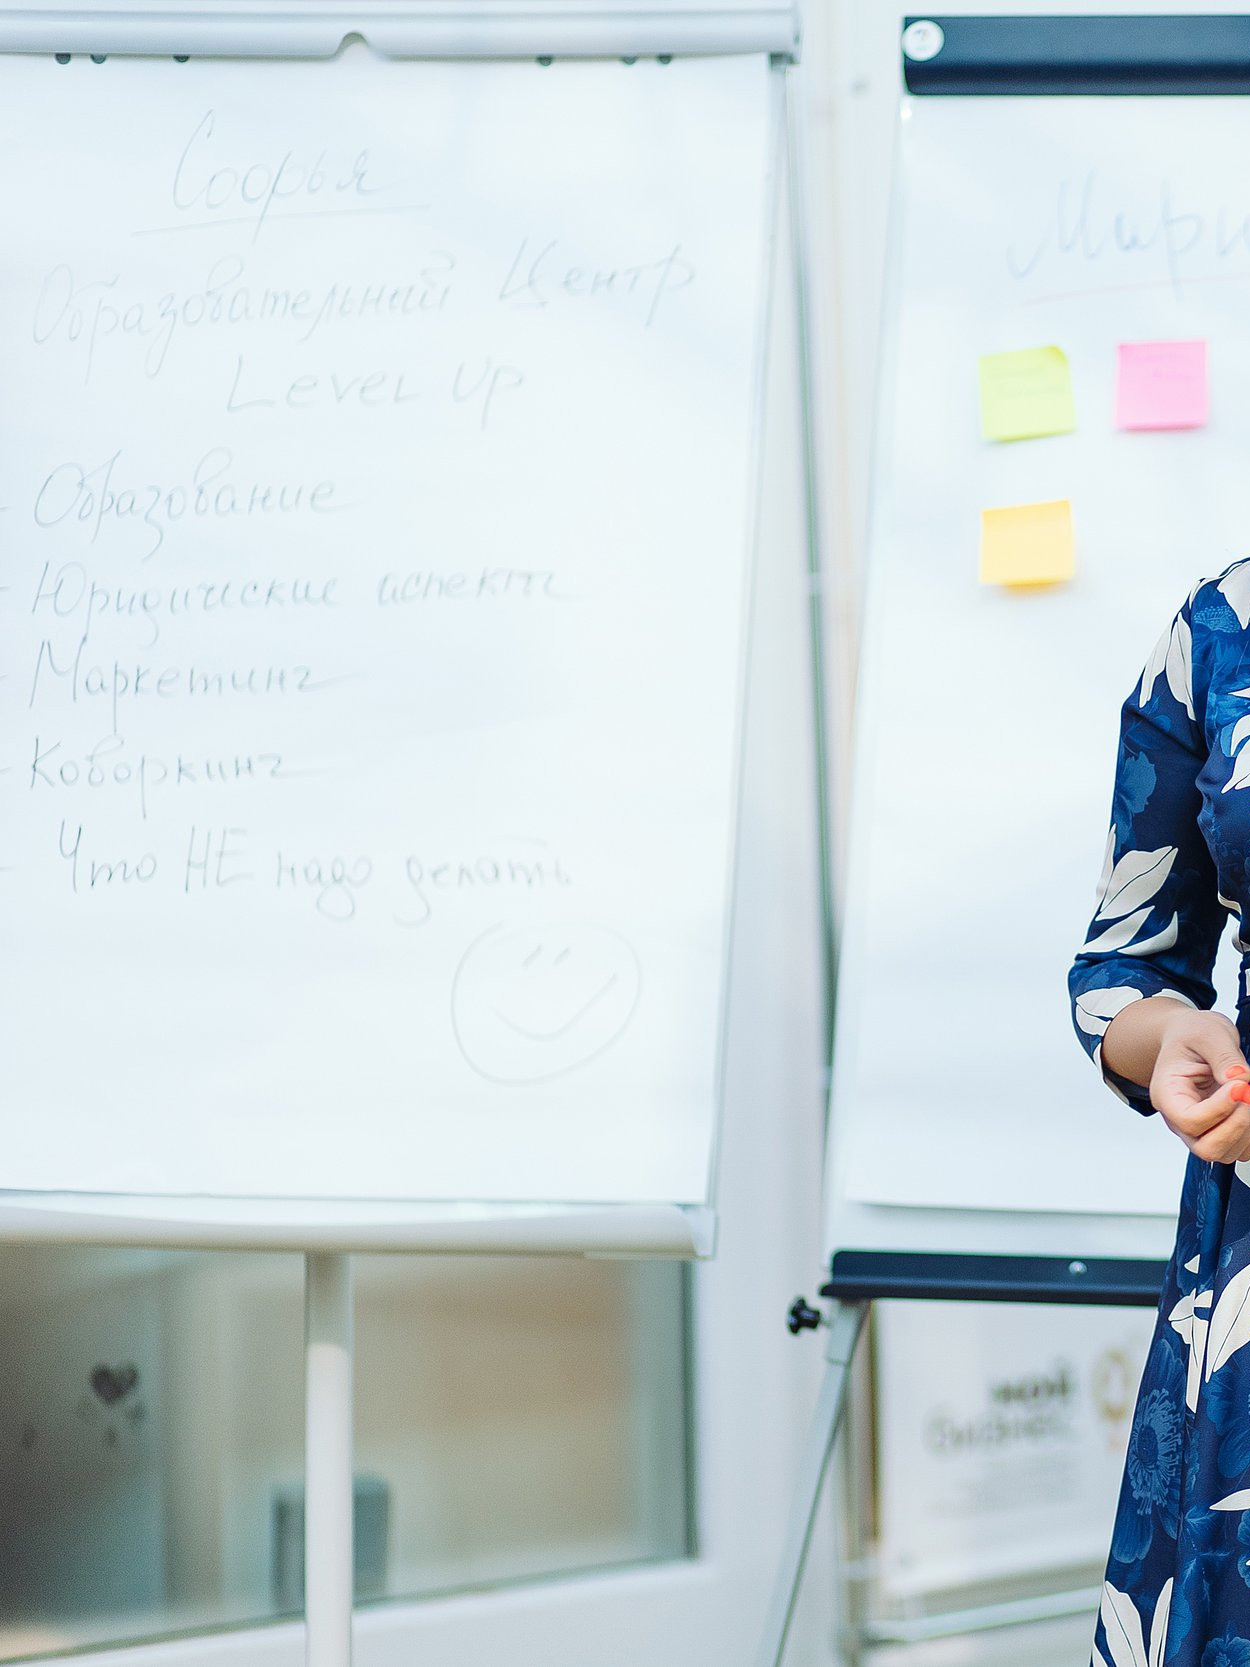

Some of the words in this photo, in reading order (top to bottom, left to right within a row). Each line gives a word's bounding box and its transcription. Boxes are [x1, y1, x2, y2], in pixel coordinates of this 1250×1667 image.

[171, 108, 389, 246] Софья
[498, 237, 698, 329] Центр
[33, 446, 352, 564] Образование
[32, 559, 342, 649] Юридические
[28, 640, 358, 735] Маркетинг
[28, 734, 330, 821] Коворкинг
[59, 817, 158, 895] Что
[185, 823, 256, 895] НЕ
[276, 850, 373, 923] надо
